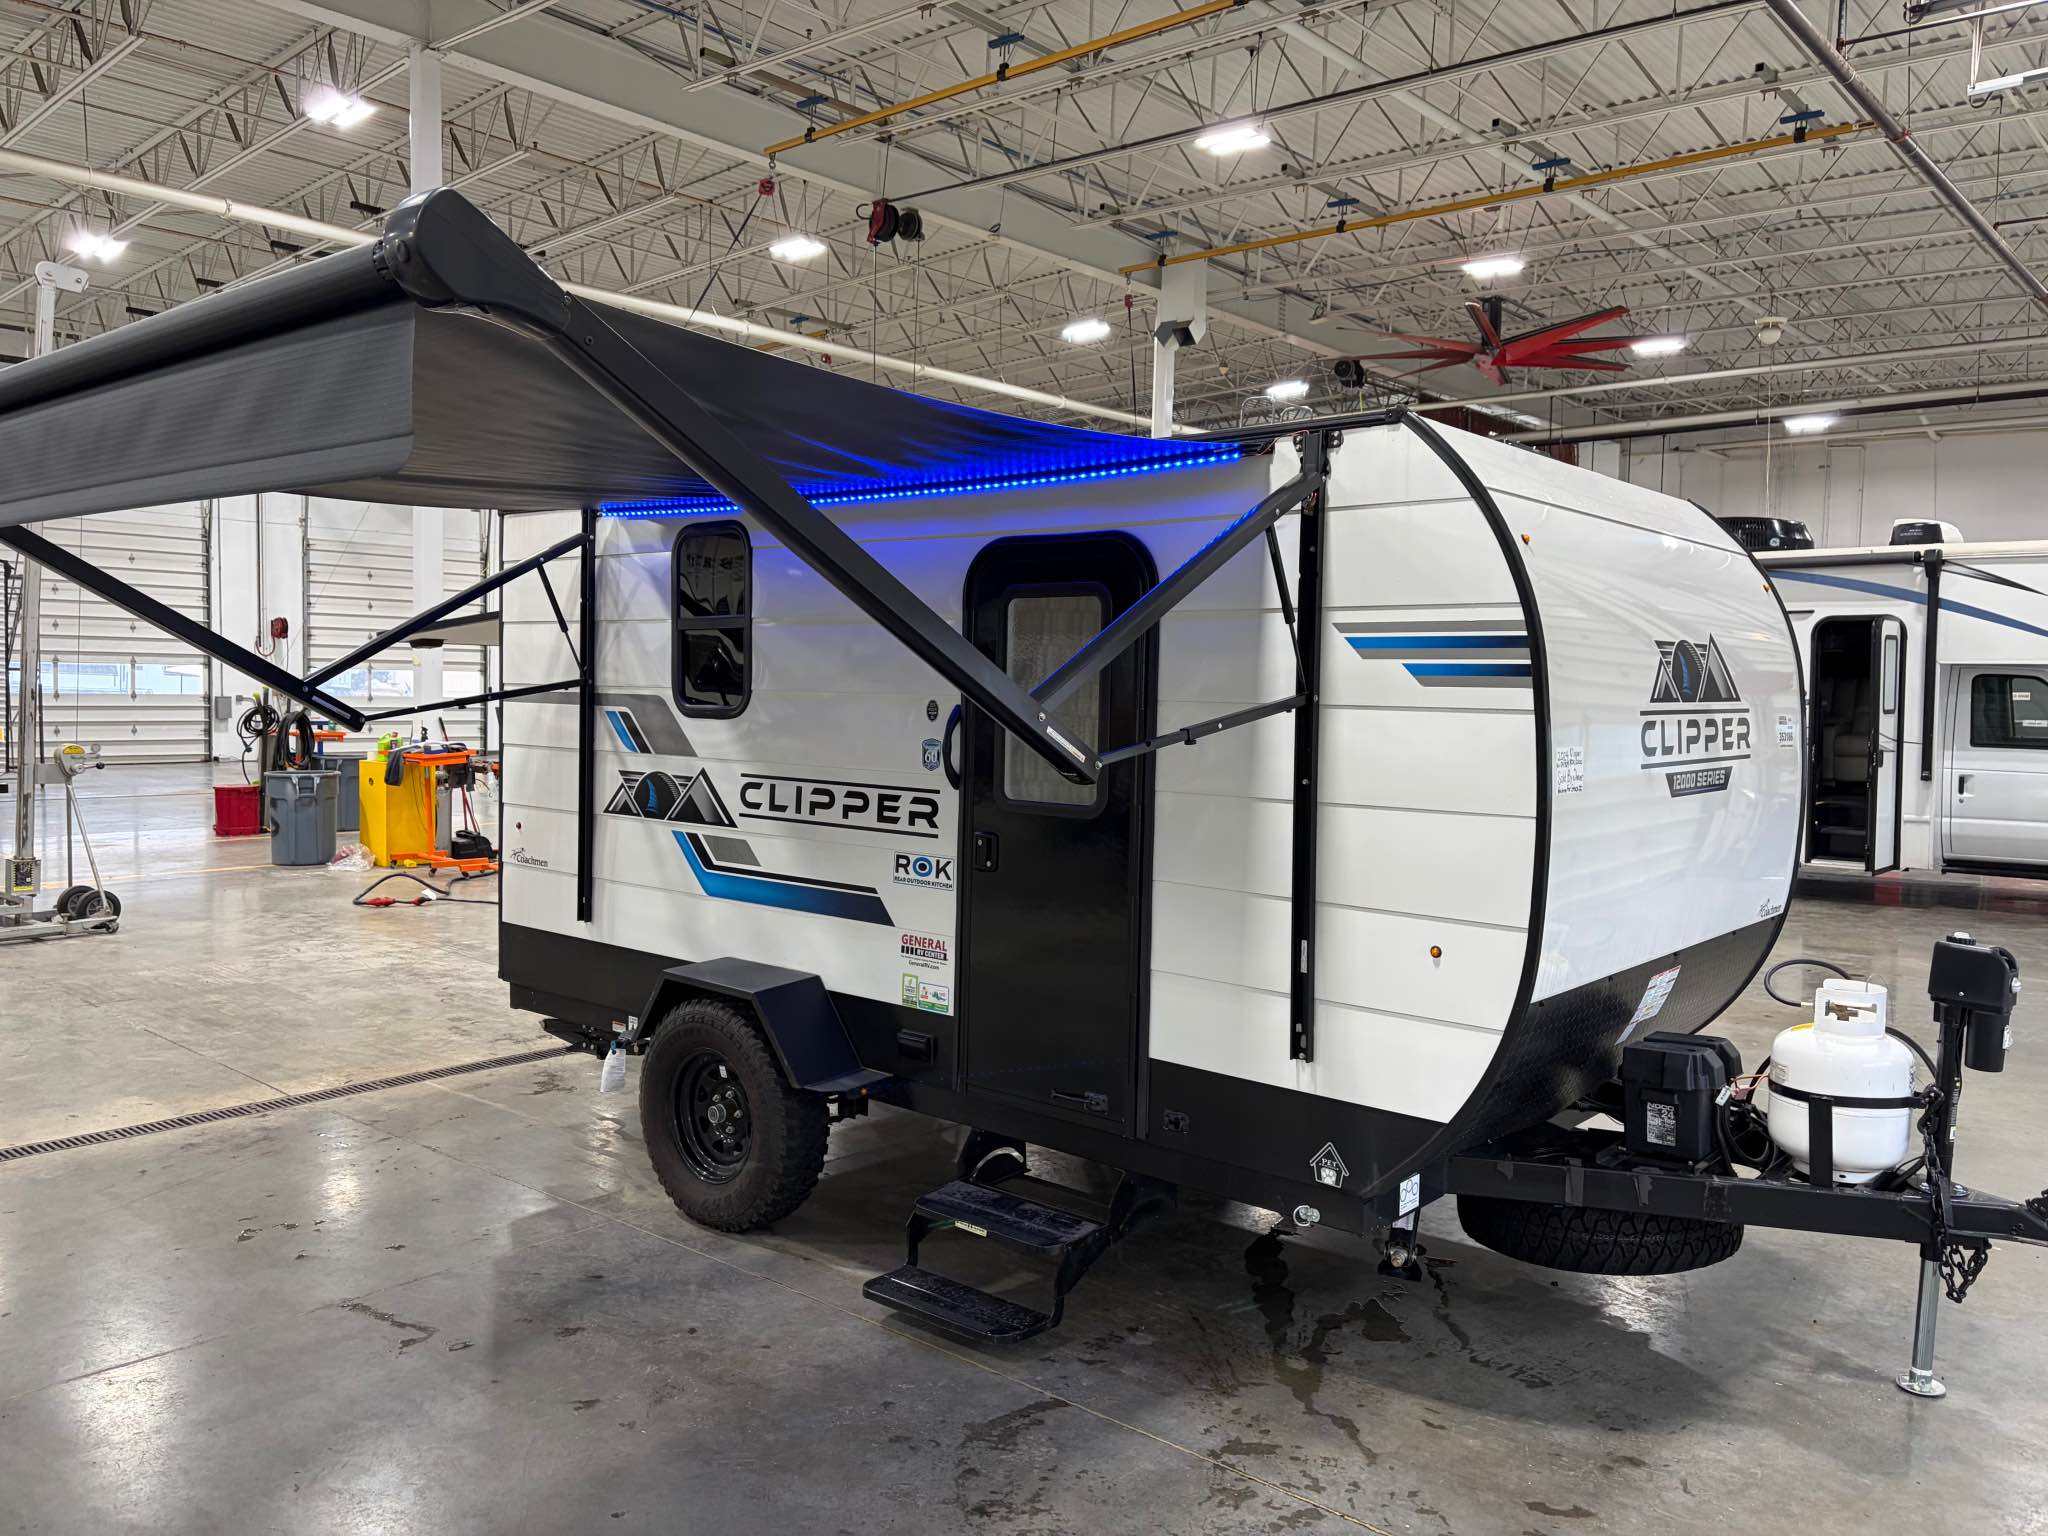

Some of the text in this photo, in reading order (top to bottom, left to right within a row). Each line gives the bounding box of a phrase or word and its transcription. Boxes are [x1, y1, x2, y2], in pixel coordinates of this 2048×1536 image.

[1641, 717, 1751, 757] CLIPPER
[1696, 769, 1726, 787] SERIES
[740, 781, 939, 829] CLIPPER
[895, 853, 952, 881] ROK
[906, 877, 931, 886] OUTDOOR
[931, 881, 953, 889] KITCHEN
[901, 933, 948, 952] GENERAL
[925, 949, 946, 960] CENTER
[1322, 1158, 1336, 1167] PET
